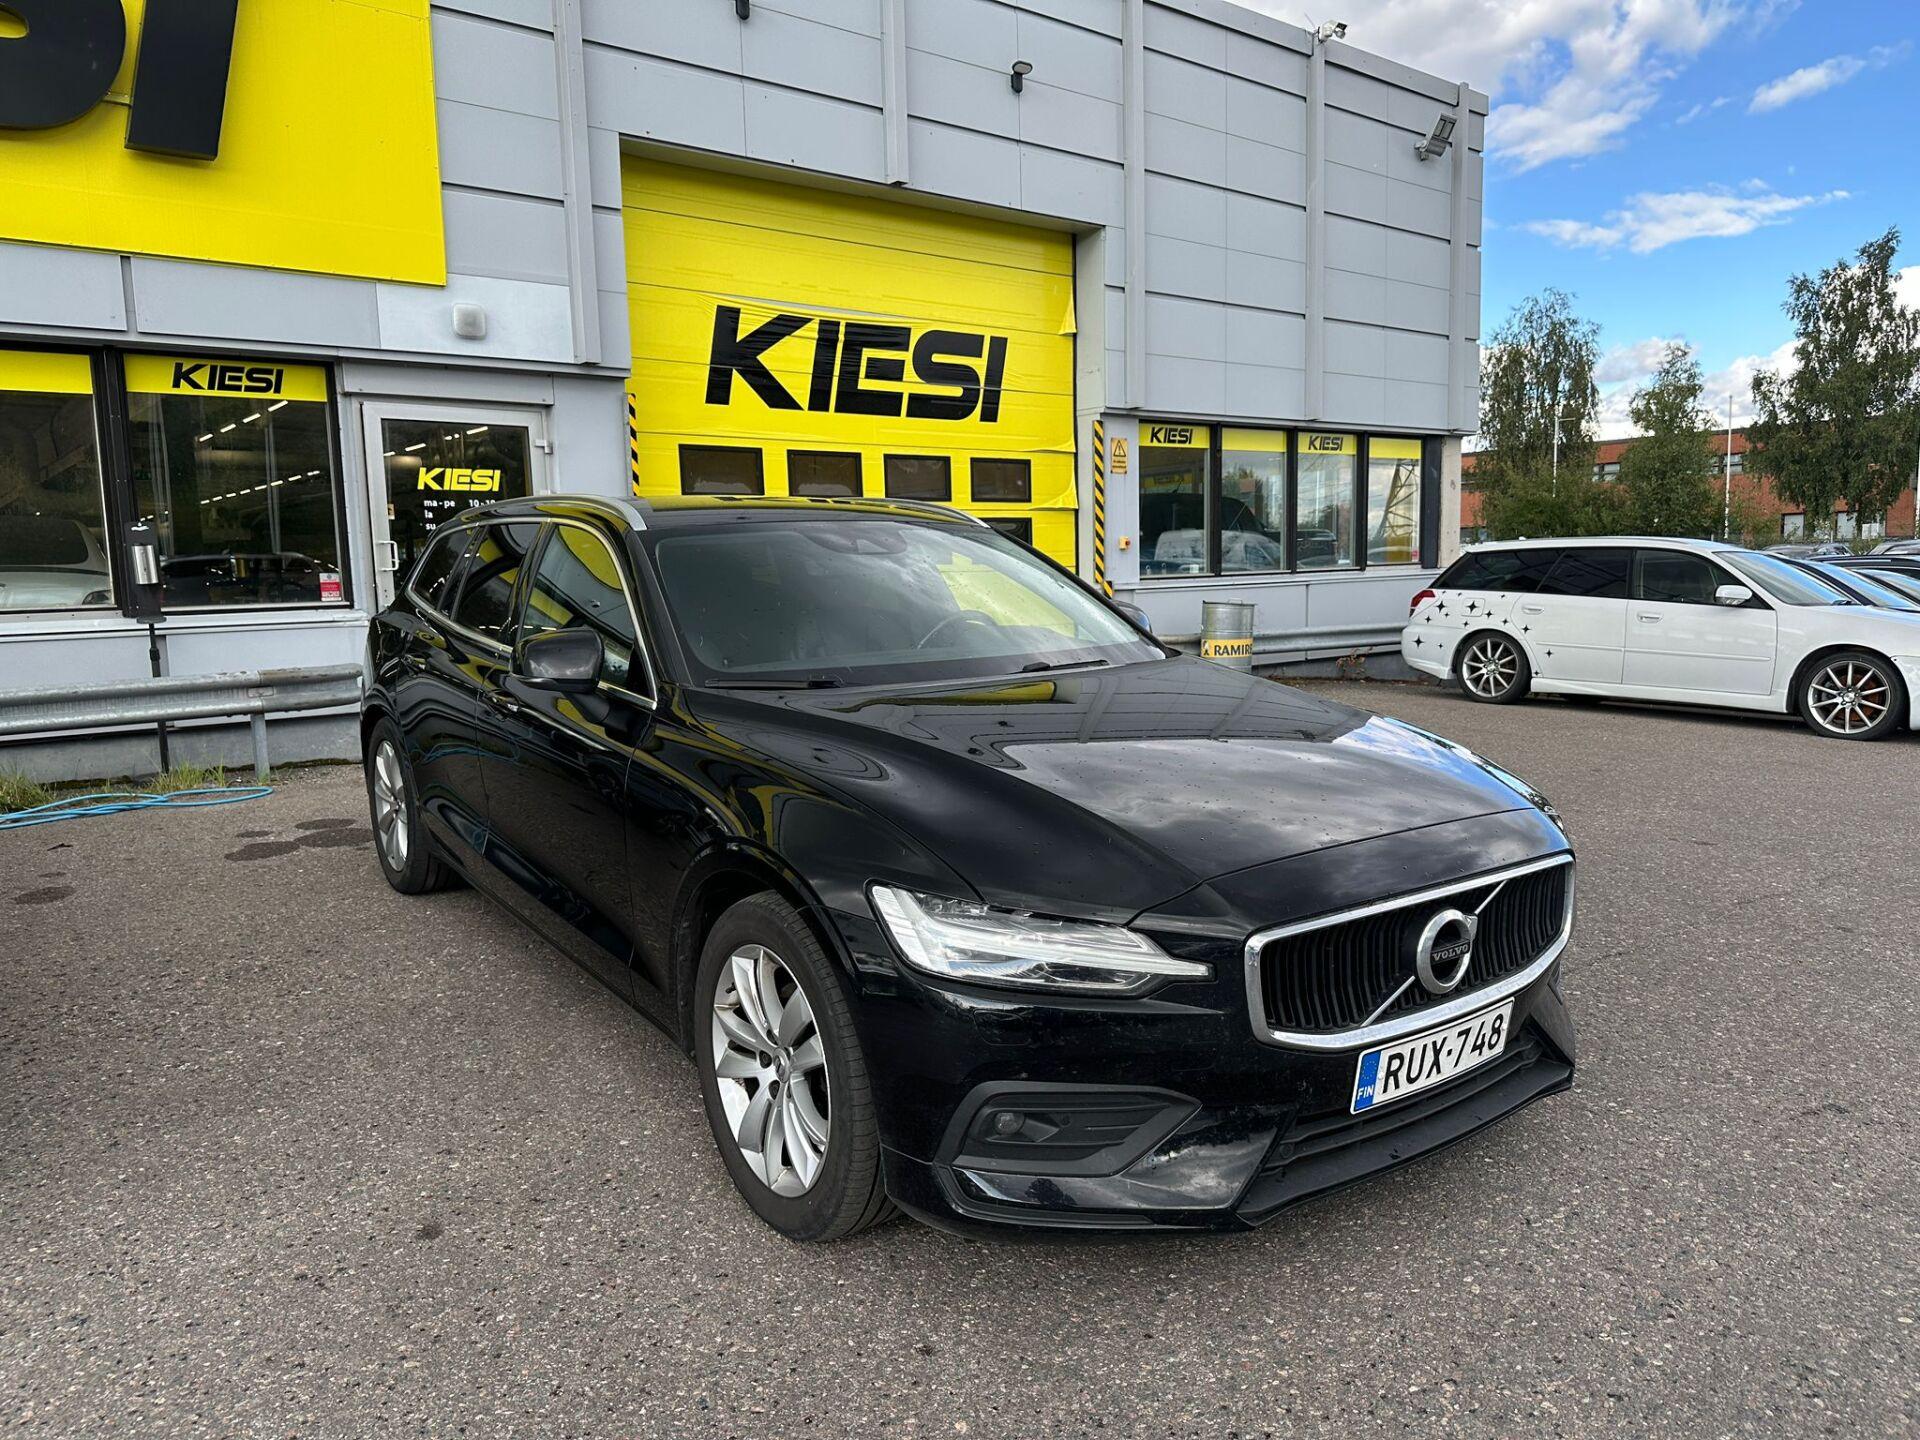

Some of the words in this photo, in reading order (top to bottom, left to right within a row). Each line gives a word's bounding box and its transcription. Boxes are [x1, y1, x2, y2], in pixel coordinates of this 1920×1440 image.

[705, 304, 1008, 422] KIESI
[172, 362, 284, 394] KIESI
[1150, 426, 1193, 444] KIESI
[1308, 435, 1343, 451] KIESI
[417, 467, 501, 492] KIESI
[424, 510, 434, 519] la
[1432, 944, 1469, 961] VOLVO
[1382, 1013, 1504, 1094] RUX-748
[1357, 1086, 1374, 1101] FIN
